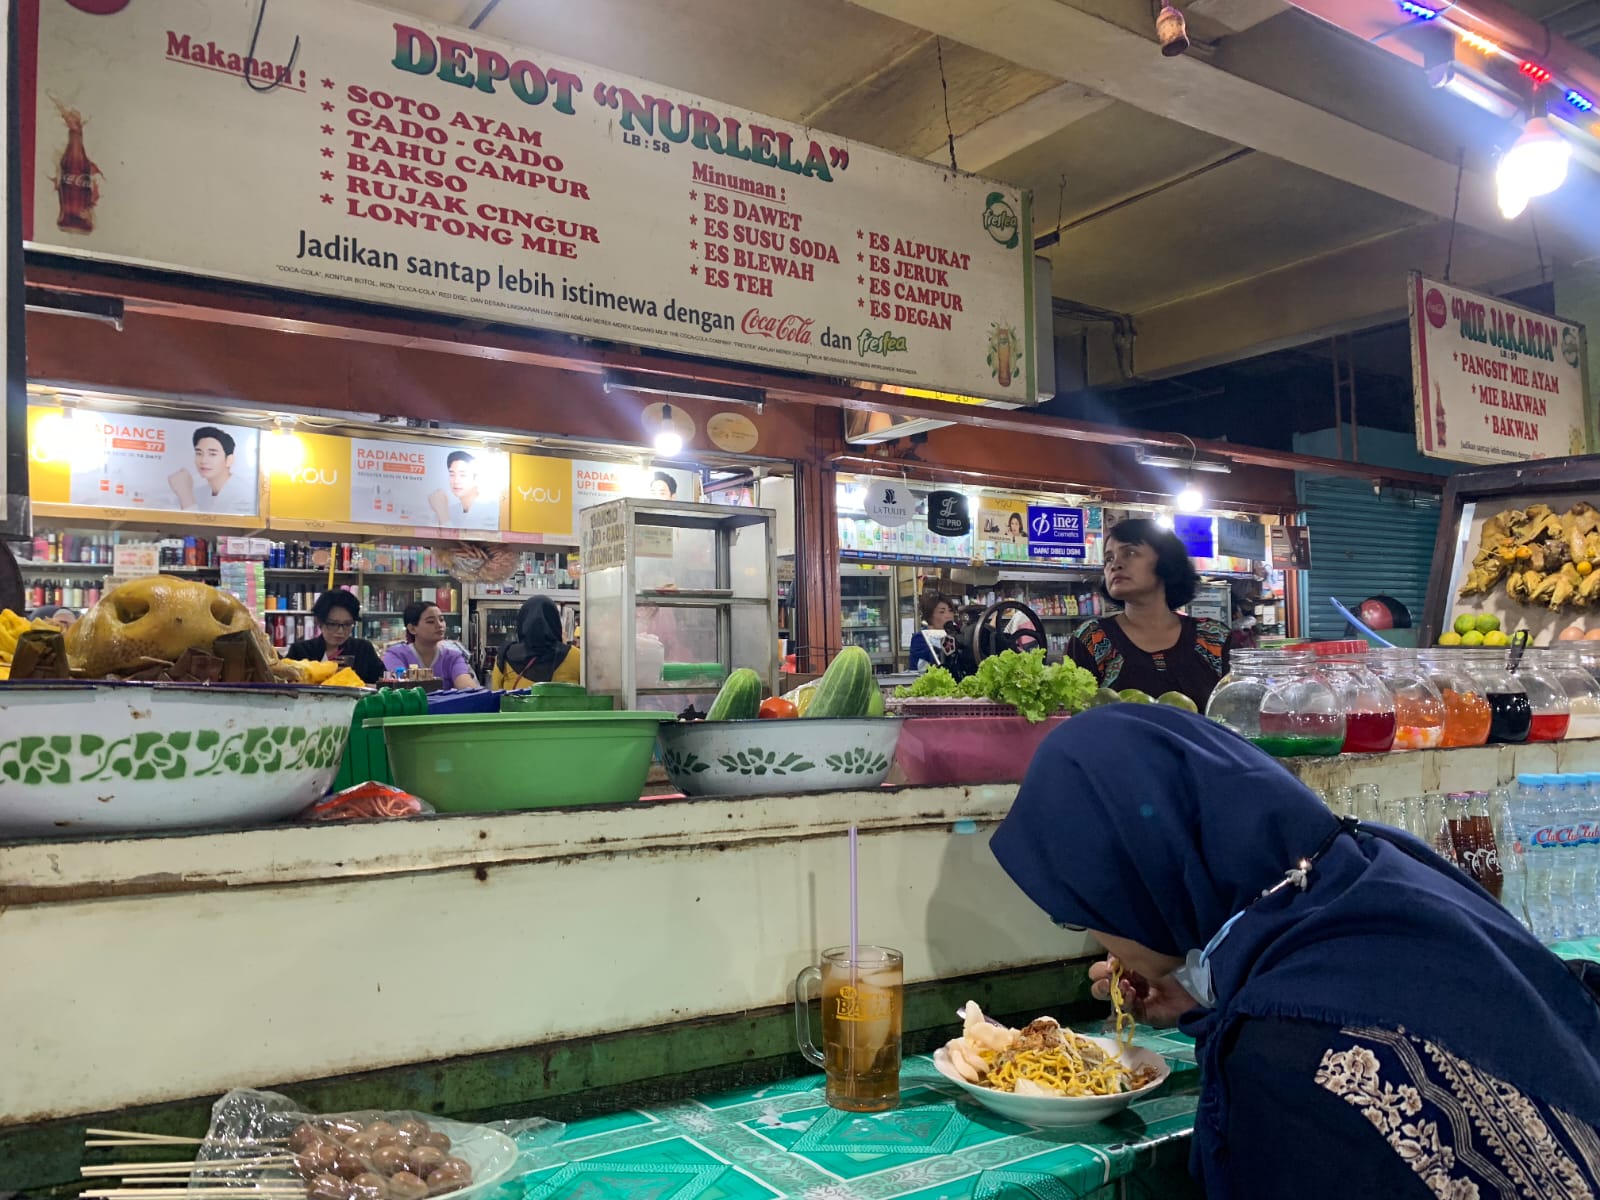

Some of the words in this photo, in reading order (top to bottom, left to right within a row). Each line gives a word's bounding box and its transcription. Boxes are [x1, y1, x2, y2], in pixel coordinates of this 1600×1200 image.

[166, 31, 292, 84] Makanan
[392, 23, 583, 115] DEPOT
[347, 85, 440, 121] SOTO
[449, 111, 542, 148] AYAM
[347, 108, 448, 145] GADO
[473, 138, 564, 172] GADO
[623, 132, 641, 146] LB
[653, 140, 670, 154] 58
[347, 130, 446, 167] TAHU
[455, 155, 590, 200] CAMPUR
[347, 152, 468, 193] BAKSO
[692, 161, 777, 200] Minuman
[347, 175, 469, 216] RUJAK
[477, 204, 600, 244] CINGUR
[347, 198, 514, 246] LONTONG
[521, 232, 578, 259] MIE
[704, 193, 729, 215] ES
[733, 199, 802, 232] DAWET
[704, 217, 729, 240] ES
[734, 227, 785, 251] SUSU
[790, 238, 840, 264] SODA
[869, 232, 890, 252] ES
[893, 241, 971, 271] ALPUKAT
[704, 242, 729, 265] ES
[734, 248, 815, 281] BLEWAH
[869, 254, 890, 275] ES
[894, 260, 949, 287] JERUK
[297, 230, 398, 270] Jadikan
[407, 256, 490, 292] santap
[498, 265, 554, 298] lebih
[562, 277, 657, 317] istimewa
[663, 298, 735, 333] dengan
[820, 326, 852, 350] dan
[704, 267, 729, 289] ES
[735, 273, 774, 297] TEH
[870, 277, 890, 297] ES
[894, 282, 963, 312] CAMPUR
[870, 300, 891, 319] ES
[894, 304, 952, 331] DEGAN
[1461, 353, 1508, 381] PANGSIT
[1511, 366, 1529, 387] MIE
[1532, 371, 1559, 394] AYAM
[1479, 385, 1499, 405] MIE
[1502, 390, 1547, 417] BAKWAN
[1492, 415, 1538, 441] BAKWAN
[357, 448, 425, 464] RADIANCE
[357, 460, 380, 470] UP!
[577, 480, 595, 490] UP!
[1053, 513, 1079, 529] inez
